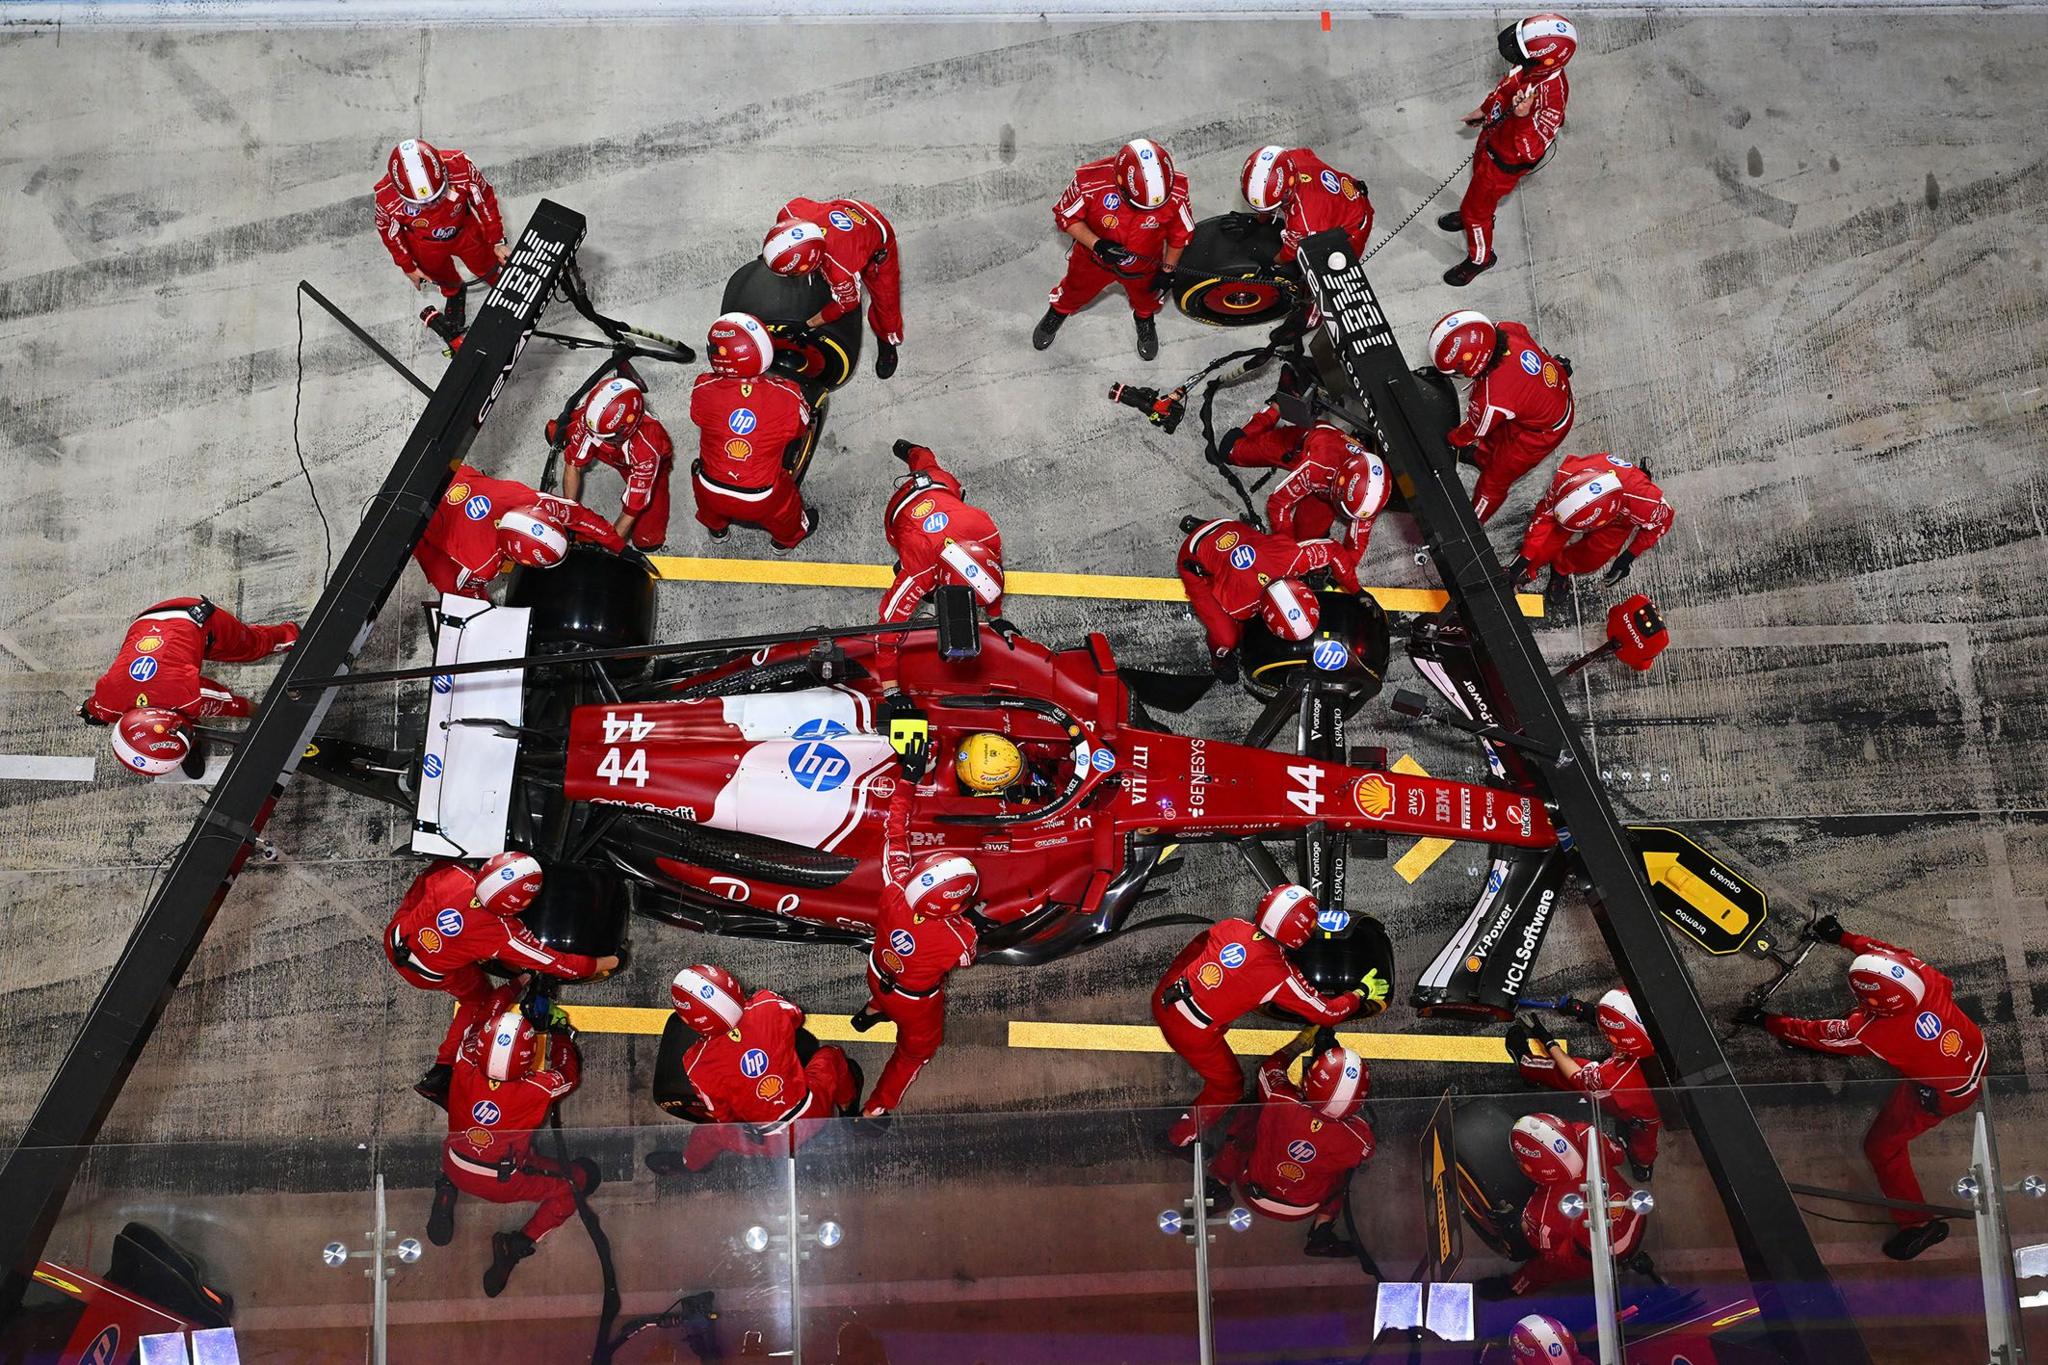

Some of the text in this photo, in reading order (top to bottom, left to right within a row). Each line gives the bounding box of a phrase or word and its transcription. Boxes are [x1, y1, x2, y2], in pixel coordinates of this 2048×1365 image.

[1104, 193, 1120, 210] hp
[487, 229, 565, 320] IBM
[1322, 266, 1393, 355] IBM
[1520, 350, 1541, 375] hp
[1341, 349, 1390, 453] LOGISTICS
[729, 408, 756, 435] hp
[465, 495, 491, 520] hp
[923, 512, 948, 533] hp
[1230, 545, 1256, 569] hp
[1623, 613, 1644, 649] brembo
[129, 656, 157, 682] hp
[1314, 641, 1348, 670] hp
[434, 673, 452, 694] hp
[1312, 698, 1321, 729] vantage
[602, 712, 656, 744] 44
[423, 753, 442, 778] hp
[596, 747, 650, 788] 44
[790, 742, 850, 792] hp
[1092, 748, 1115, 773] hp
[1190, 739, 1205, 806] GENESYS
[1287, 764, 1325, 815] 44
[1408, 788, 1419, 815] aws
[1436, 788, 1450, 822] IBM
[1461, 788, 1471, 829] PIRELLI
[1521, 798, 1531, 837] UniCredit
[908, 832, 945, 846] BM
[984, 842, 1009, 851] aws
[1312, 840, 1322, 876] vantage
[1709, 867, 1742, 894] brembo
[436, 908, 463, 937] hp
[1474, 903, 1513, 958] V-Power
[1675, 908, 1707, 936] brembo
[890, 929, 915, 957] hp
[1220, 943, 1246, 968] hp
[1501, 889, 1554, 996] HCLSoftware
[1915, 1011, 1942, 1040] hp
[497, 1034, 511, 1046] hp
[740, 1048, 769, 1078] hp
[472, 1100, 500, 1126] hp
[1288, 1140, 1316, 1163] hp
